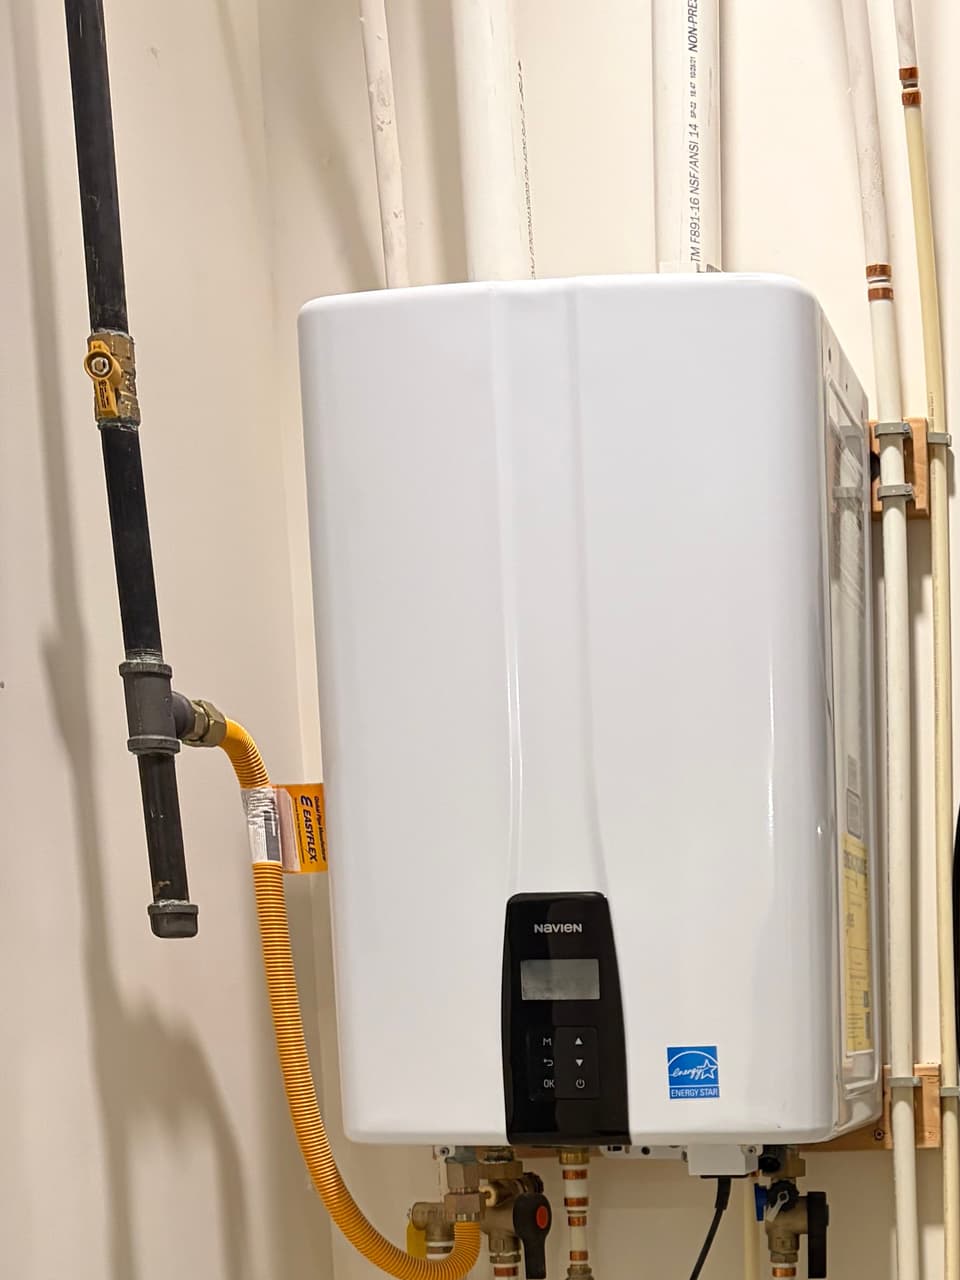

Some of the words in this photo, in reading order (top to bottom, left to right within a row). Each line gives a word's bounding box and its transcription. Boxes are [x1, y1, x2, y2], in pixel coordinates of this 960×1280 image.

[688, 123, 699, 138] 14
[688, 140, 700, 195] NSF/ANSI
[689, 197, 701, 243] F891-16
[303, 809, 318, 862] EASYFLEX
[543, 1079, 555, 1088] OK
[671, 1088, 699, 1097] ENERGY
